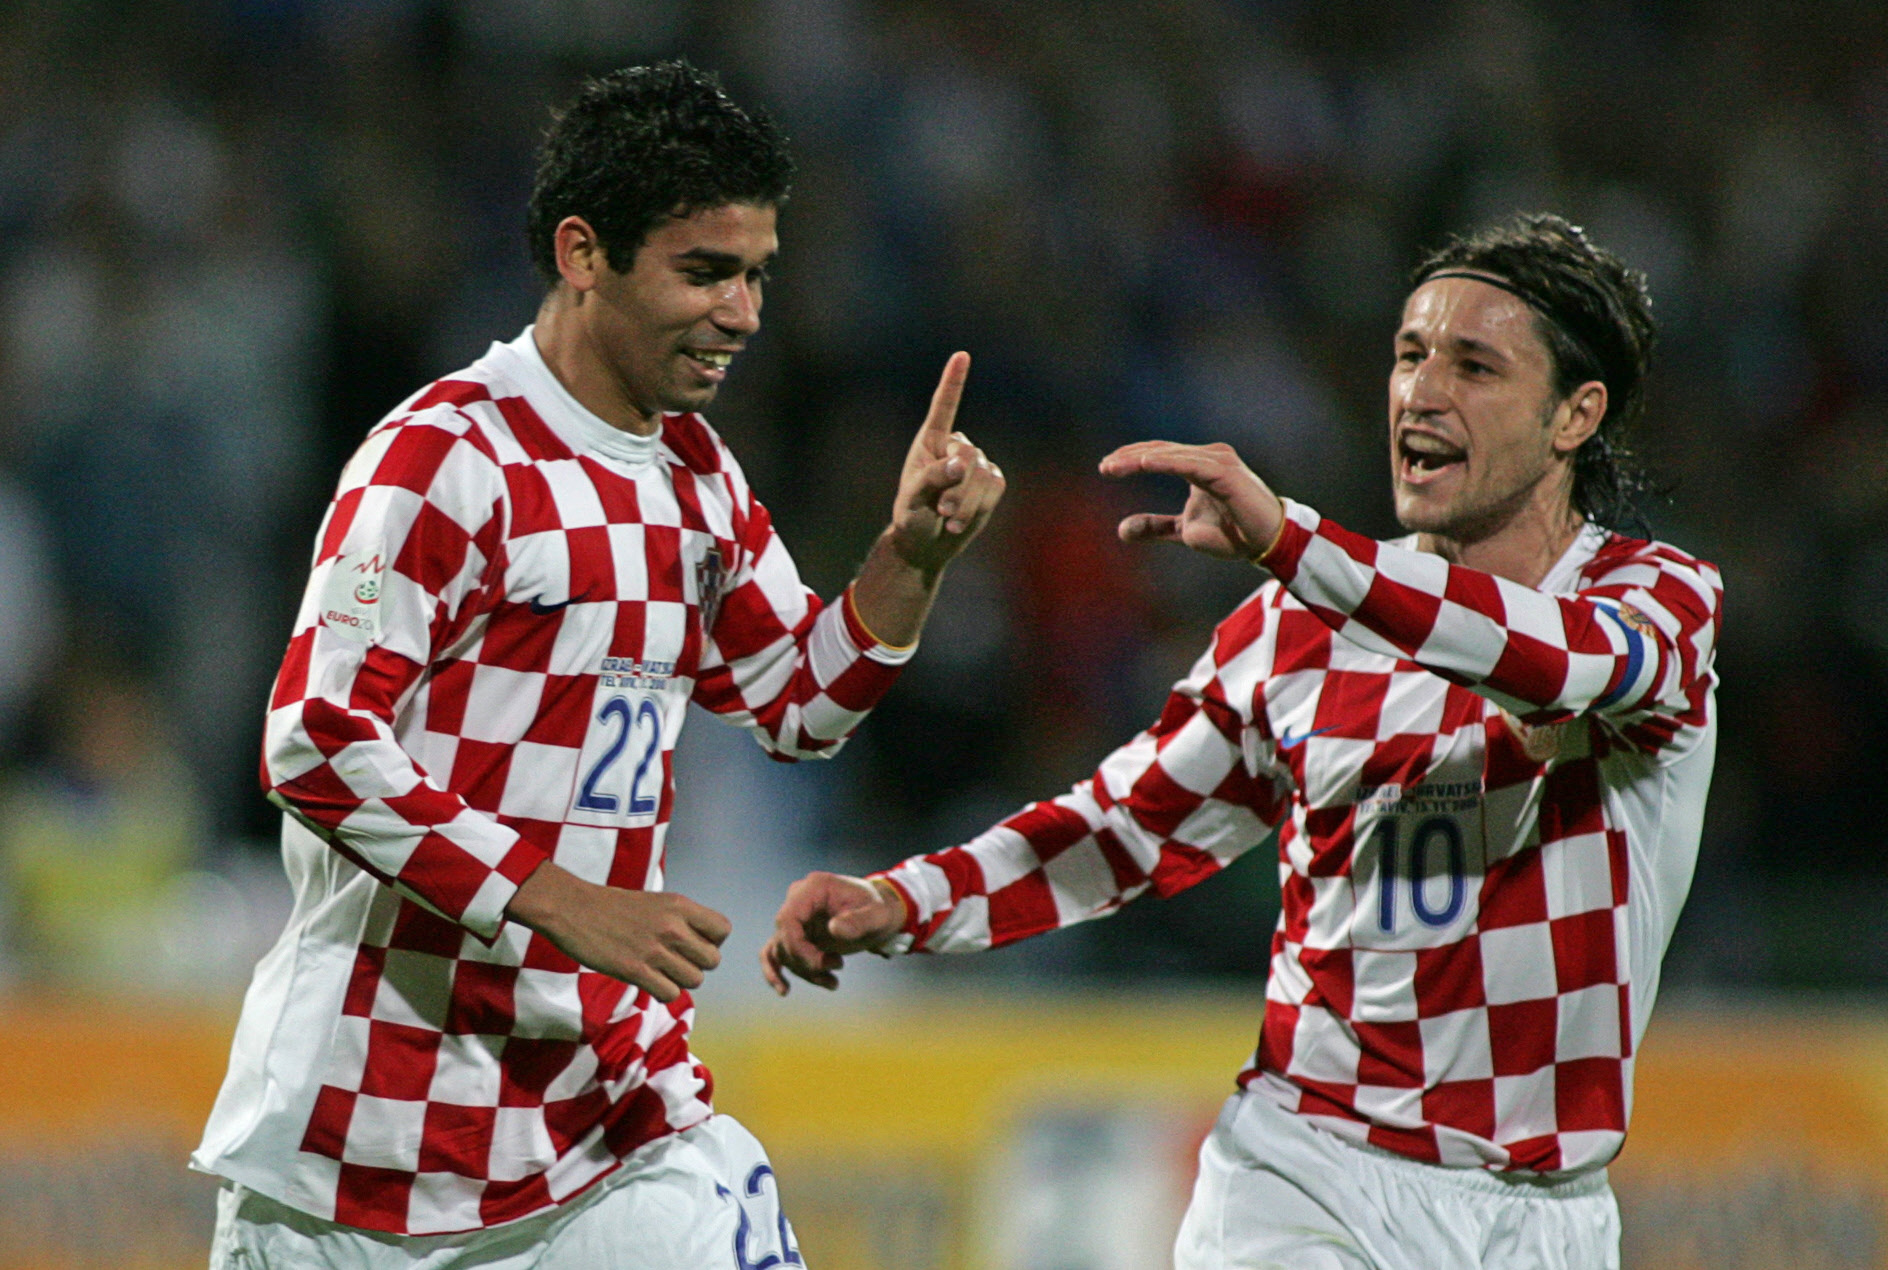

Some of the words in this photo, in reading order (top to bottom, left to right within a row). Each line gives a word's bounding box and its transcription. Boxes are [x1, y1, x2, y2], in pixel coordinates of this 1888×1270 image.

[326, 610, 360, 627] EURO
[574, 695, 660, 816] 22
[1376, 814, 1467, 934] 10
[714, 1161, 802, 1270] 22
